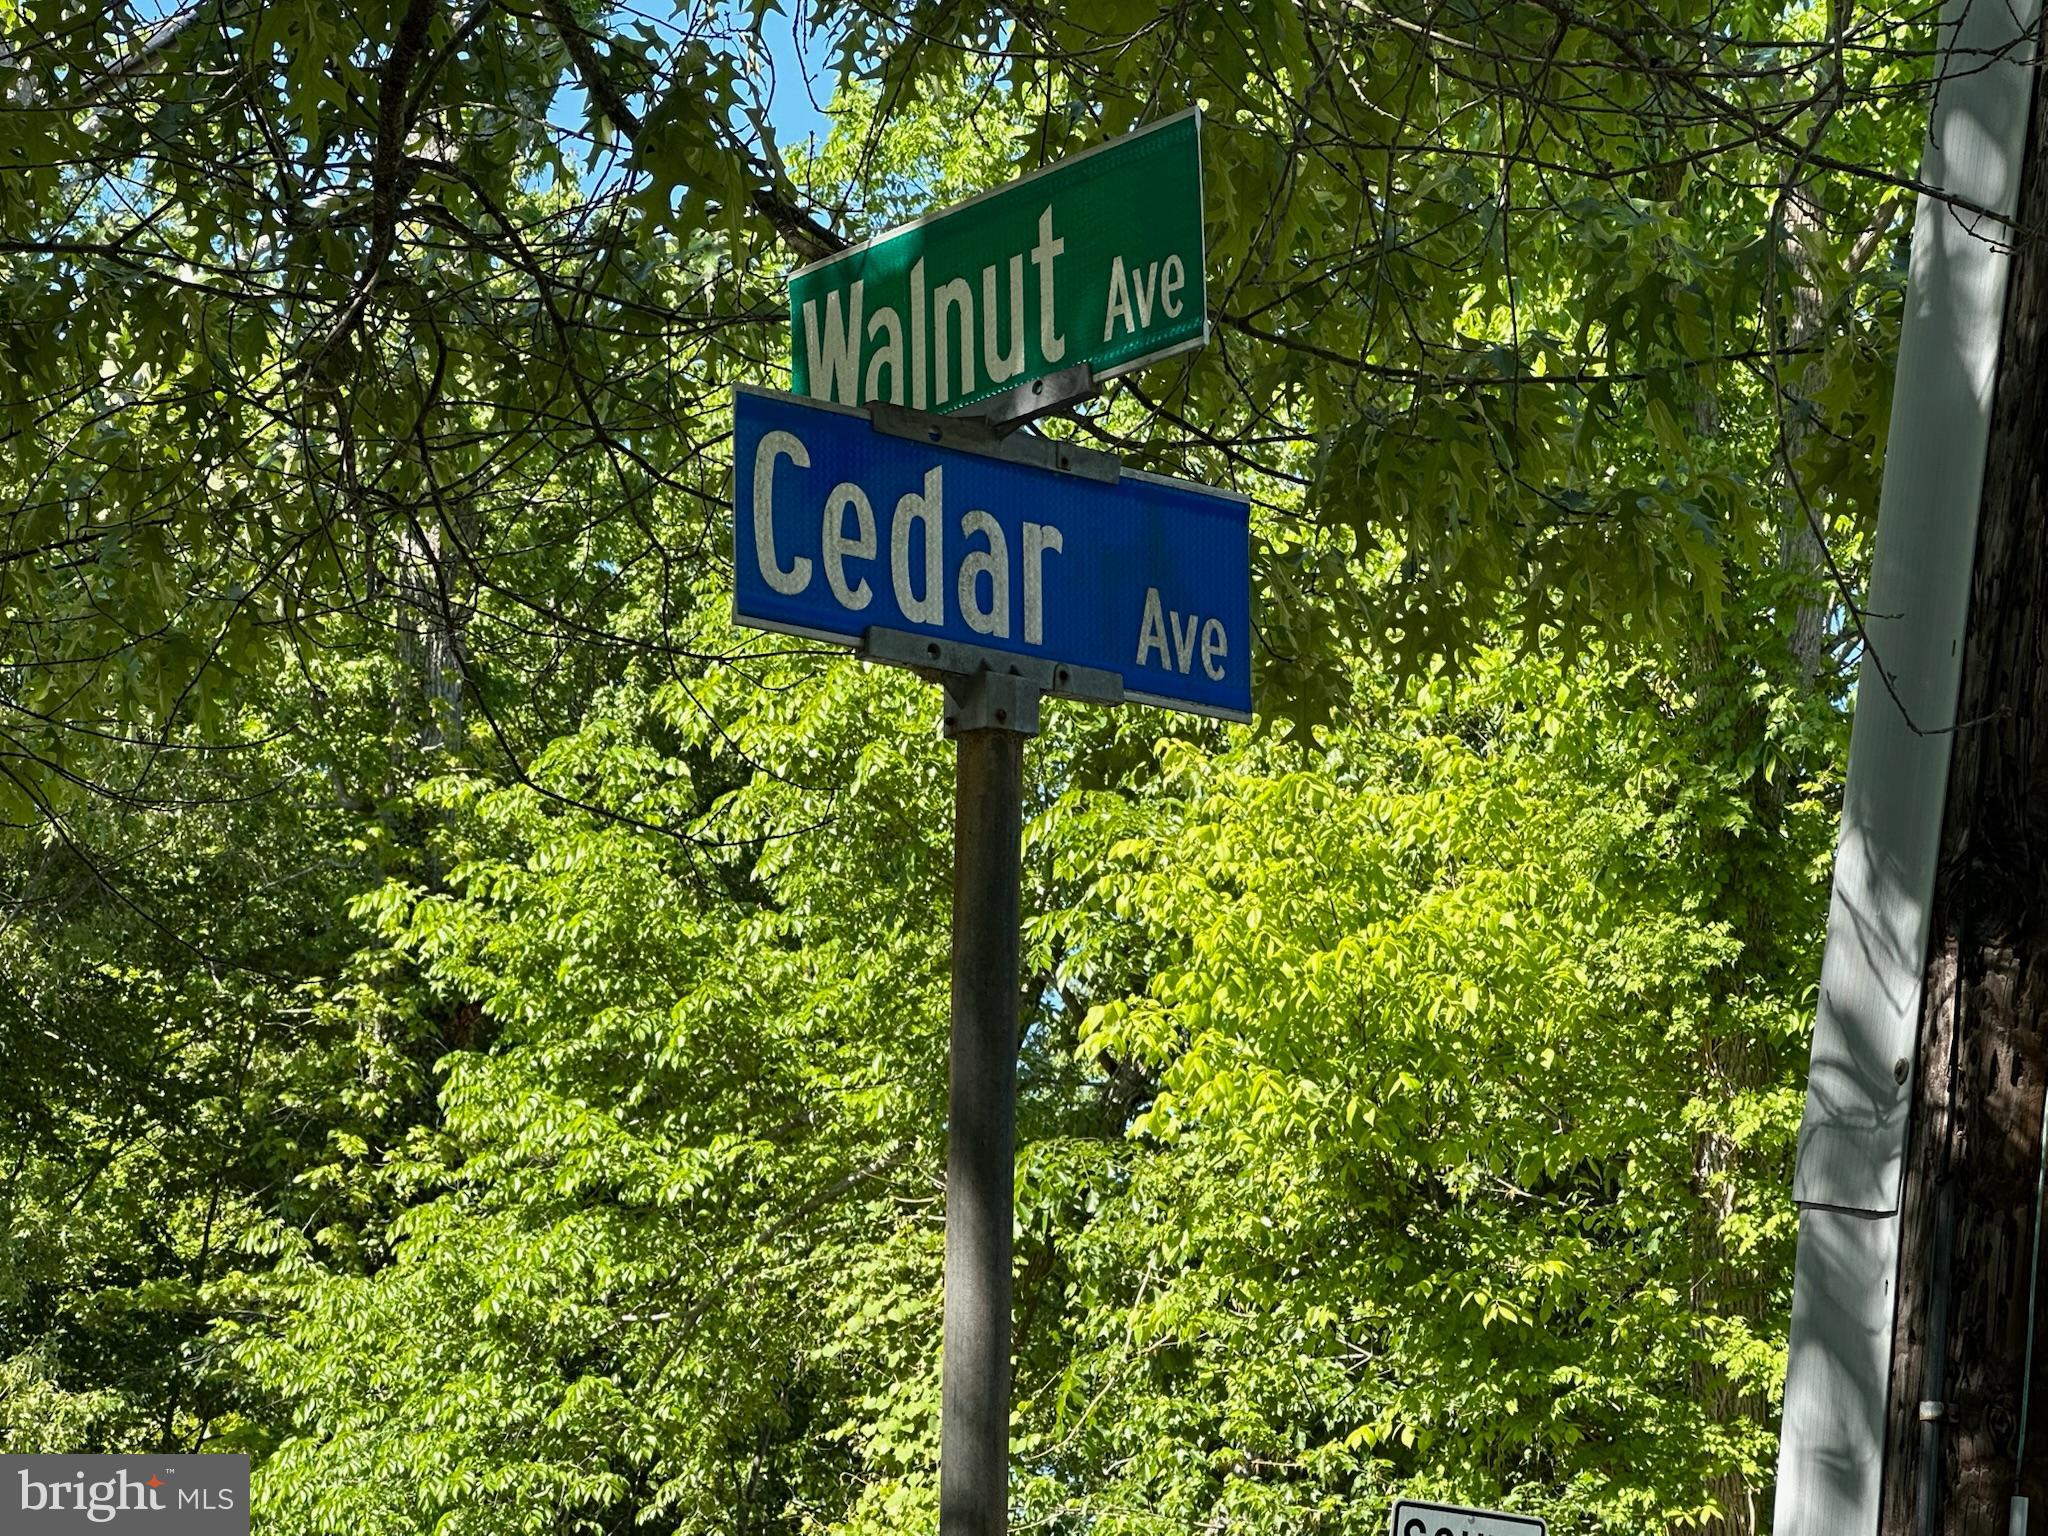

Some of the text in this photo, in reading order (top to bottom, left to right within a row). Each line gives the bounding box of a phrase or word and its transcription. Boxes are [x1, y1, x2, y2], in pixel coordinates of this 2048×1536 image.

[802, 203, 1186, 411] Walnut Ave
[752, 430, 1229, 683] Cedar Ave
